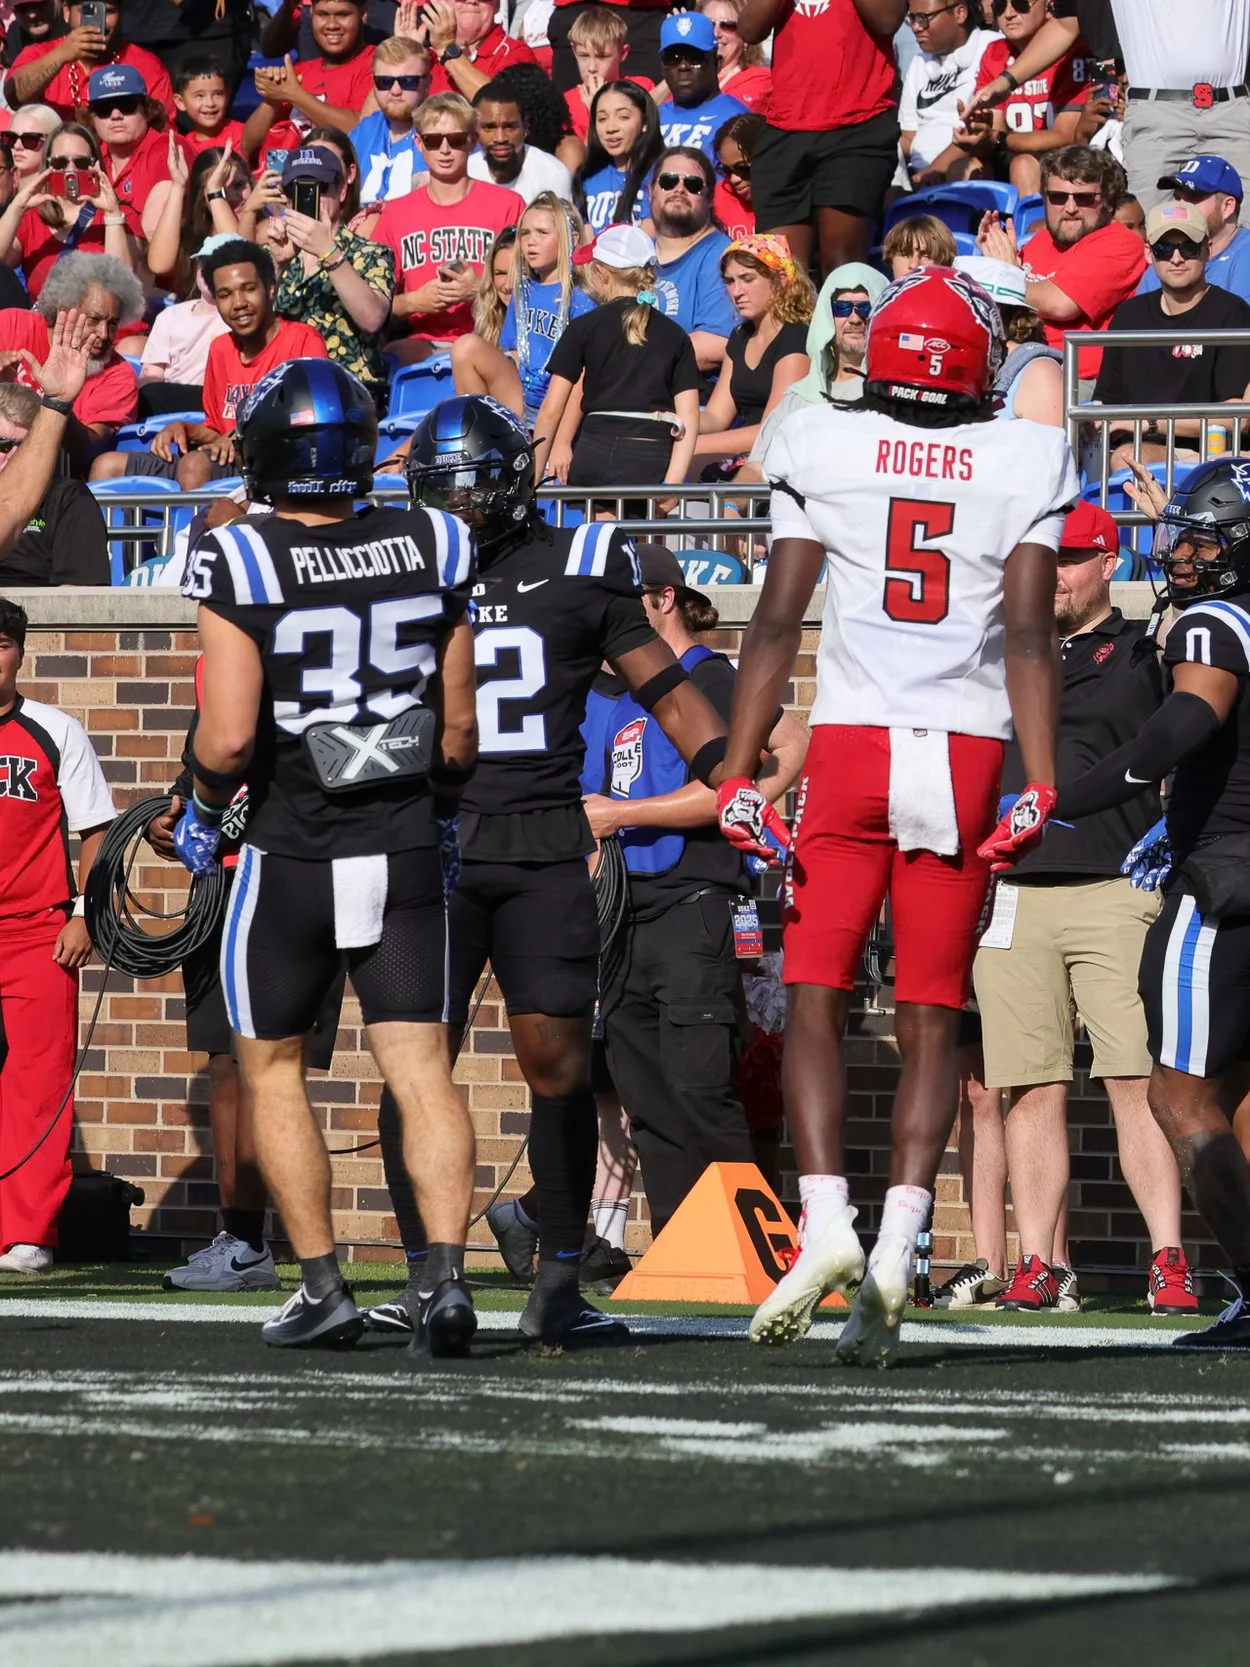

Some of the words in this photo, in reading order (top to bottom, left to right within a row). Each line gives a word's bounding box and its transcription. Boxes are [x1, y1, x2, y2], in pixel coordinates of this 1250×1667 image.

[1024, 78, 1048, 96] STATE
[401, 230, 427, 272] NC
[929, 353, 943, 376] 5
[875, 439, 973, 482] ROGERS
[290, 535, 427, 584] PELLICCIOTTA
[882, 497, 955, 624] 5
[478, 604, 508, 623] KE
[272, 594, 443, 735] 35
[734, 914, 759, 928] 2025
[734, 1188, 797, 1285] G
